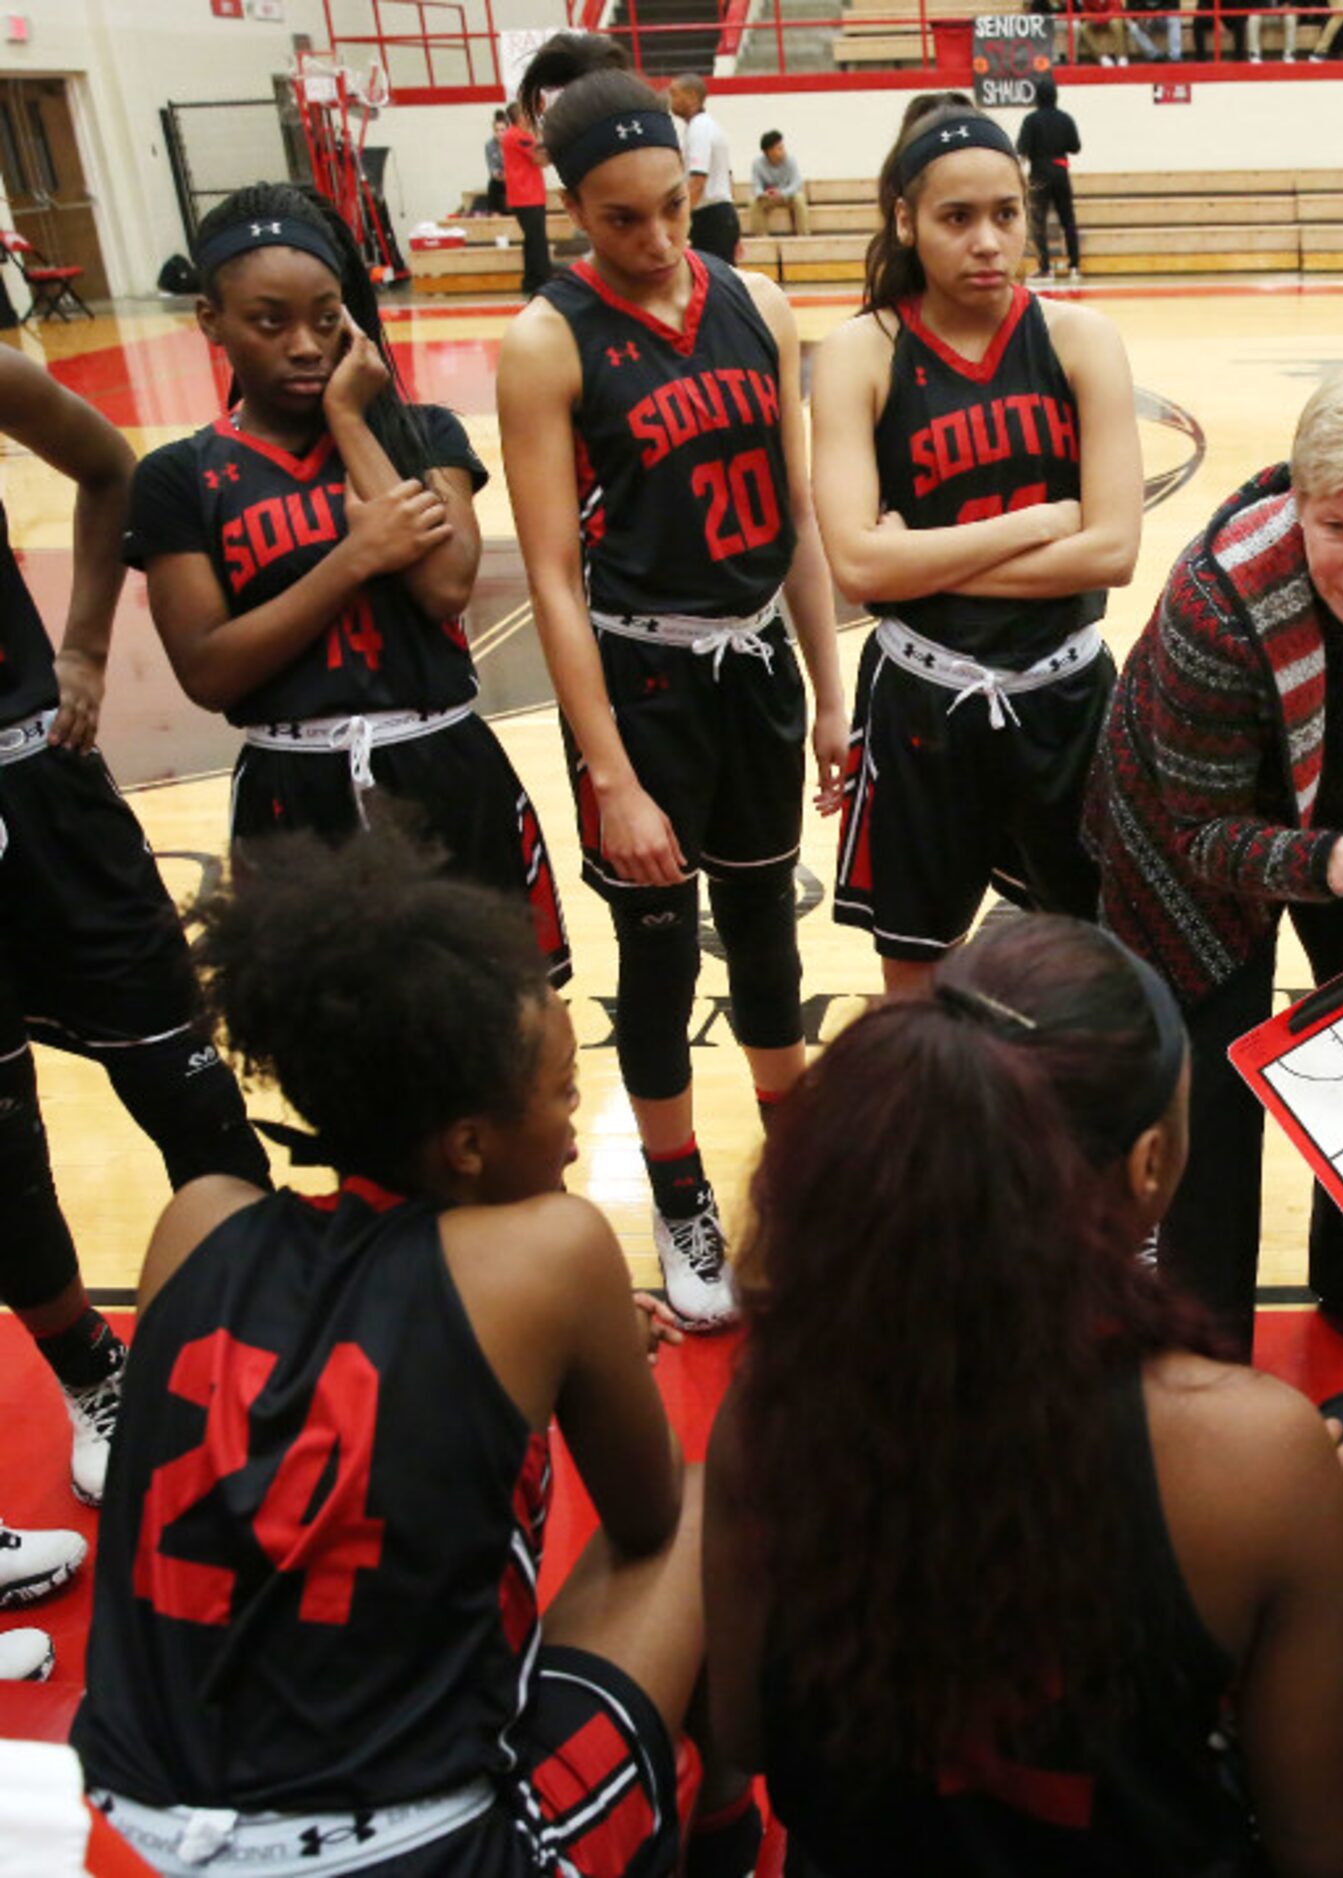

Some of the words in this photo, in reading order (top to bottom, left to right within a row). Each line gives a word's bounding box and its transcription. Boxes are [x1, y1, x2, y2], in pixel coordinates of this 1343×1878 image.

[975, 14, 1047, 38] SENIOR
[627, 367, 780, 469] SOUTH
[910, 393, 1080, 497] SOUTH
[222, 484, 347, 595] SOU
[691, 447, 781, 561] 20
[132, 1328, 385, 1626] 24
